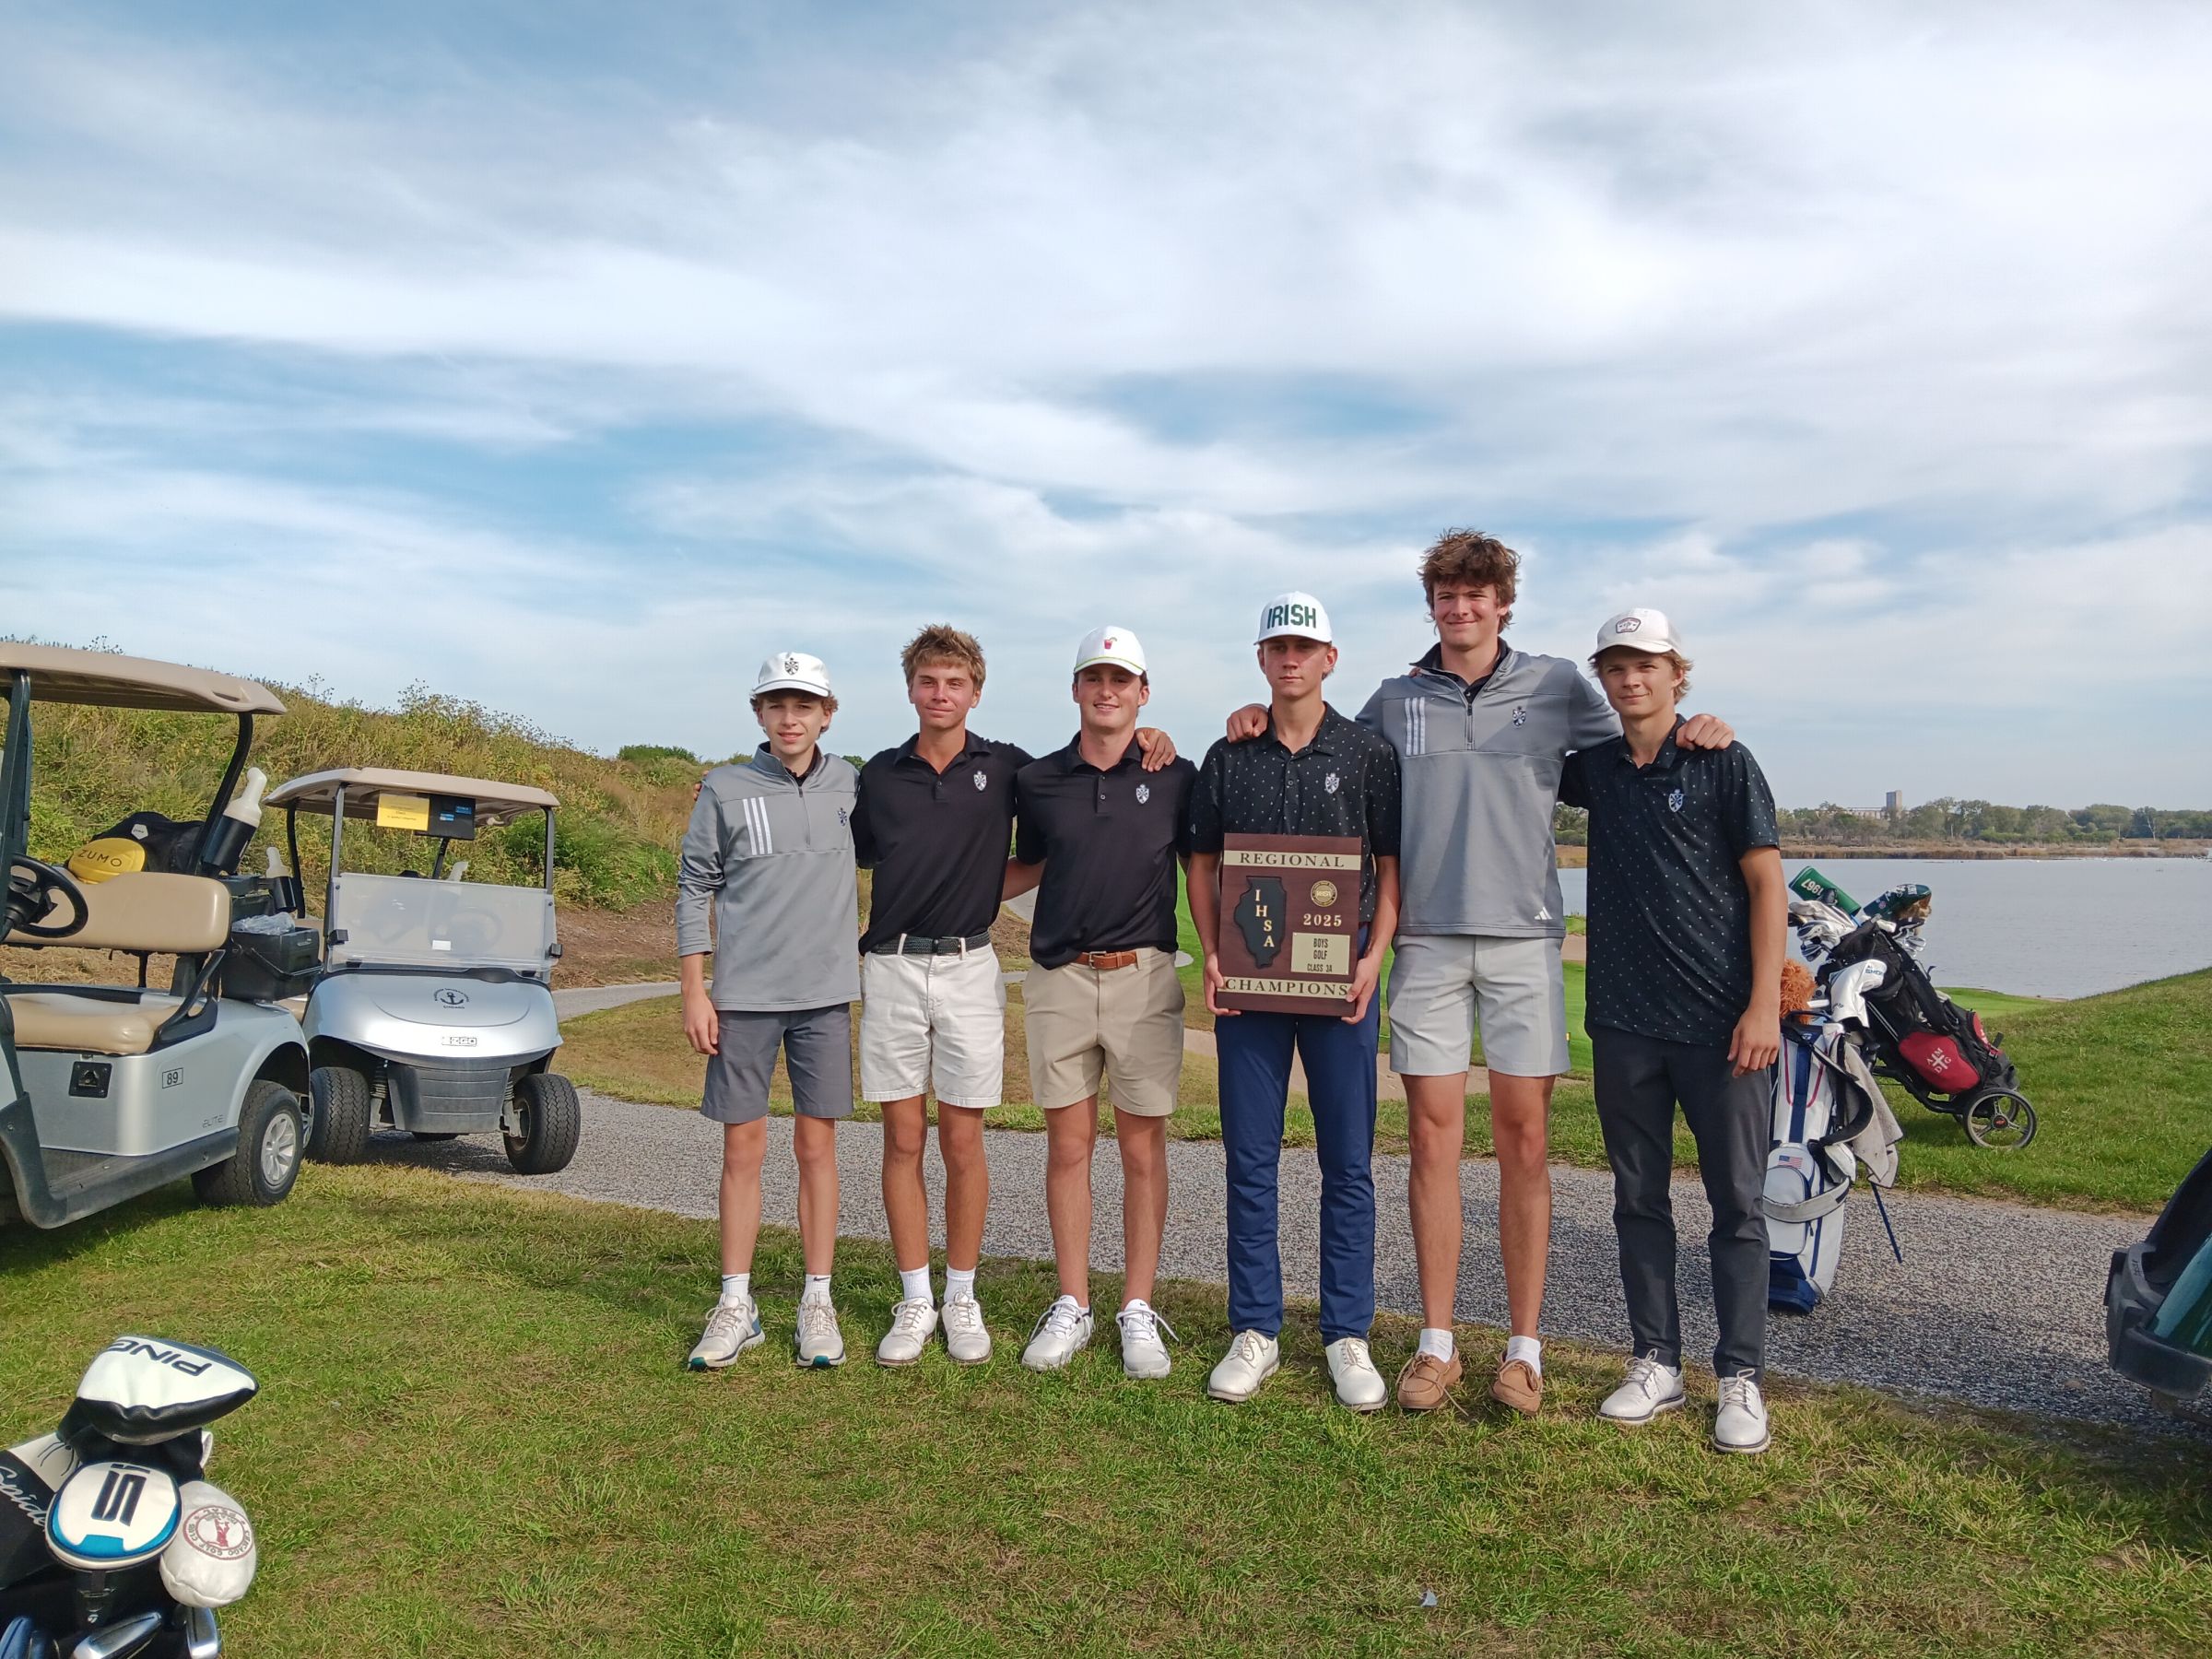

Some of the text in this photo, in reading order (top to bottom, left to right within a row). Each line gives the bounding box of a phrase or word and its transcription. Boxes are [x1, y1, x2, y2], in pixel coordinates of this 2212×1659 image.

[1266, 604, 1317, 629] IRISH
[77, 849, 123, 867] ZUMO
[1240, 852, 1345, 868] REGIONAL
[1800, 877, 1824, 896] 1967
[1302, 912, 1343, 927] 2025
[1312, 937, 1329, 948] BOYS
[1312, 949, 1328, 960] GOLF
[1306, 963, 1324, 972] CLASS
[1225, 978, 1348, 996] CHAMPIONS
[166, 1071, 179, 1086] 89
[106, 1339, 213, 1377] PING
[199, 1542, 223, 1556] GOLF
[228, 1530, 252, 1556] CHICAGO
